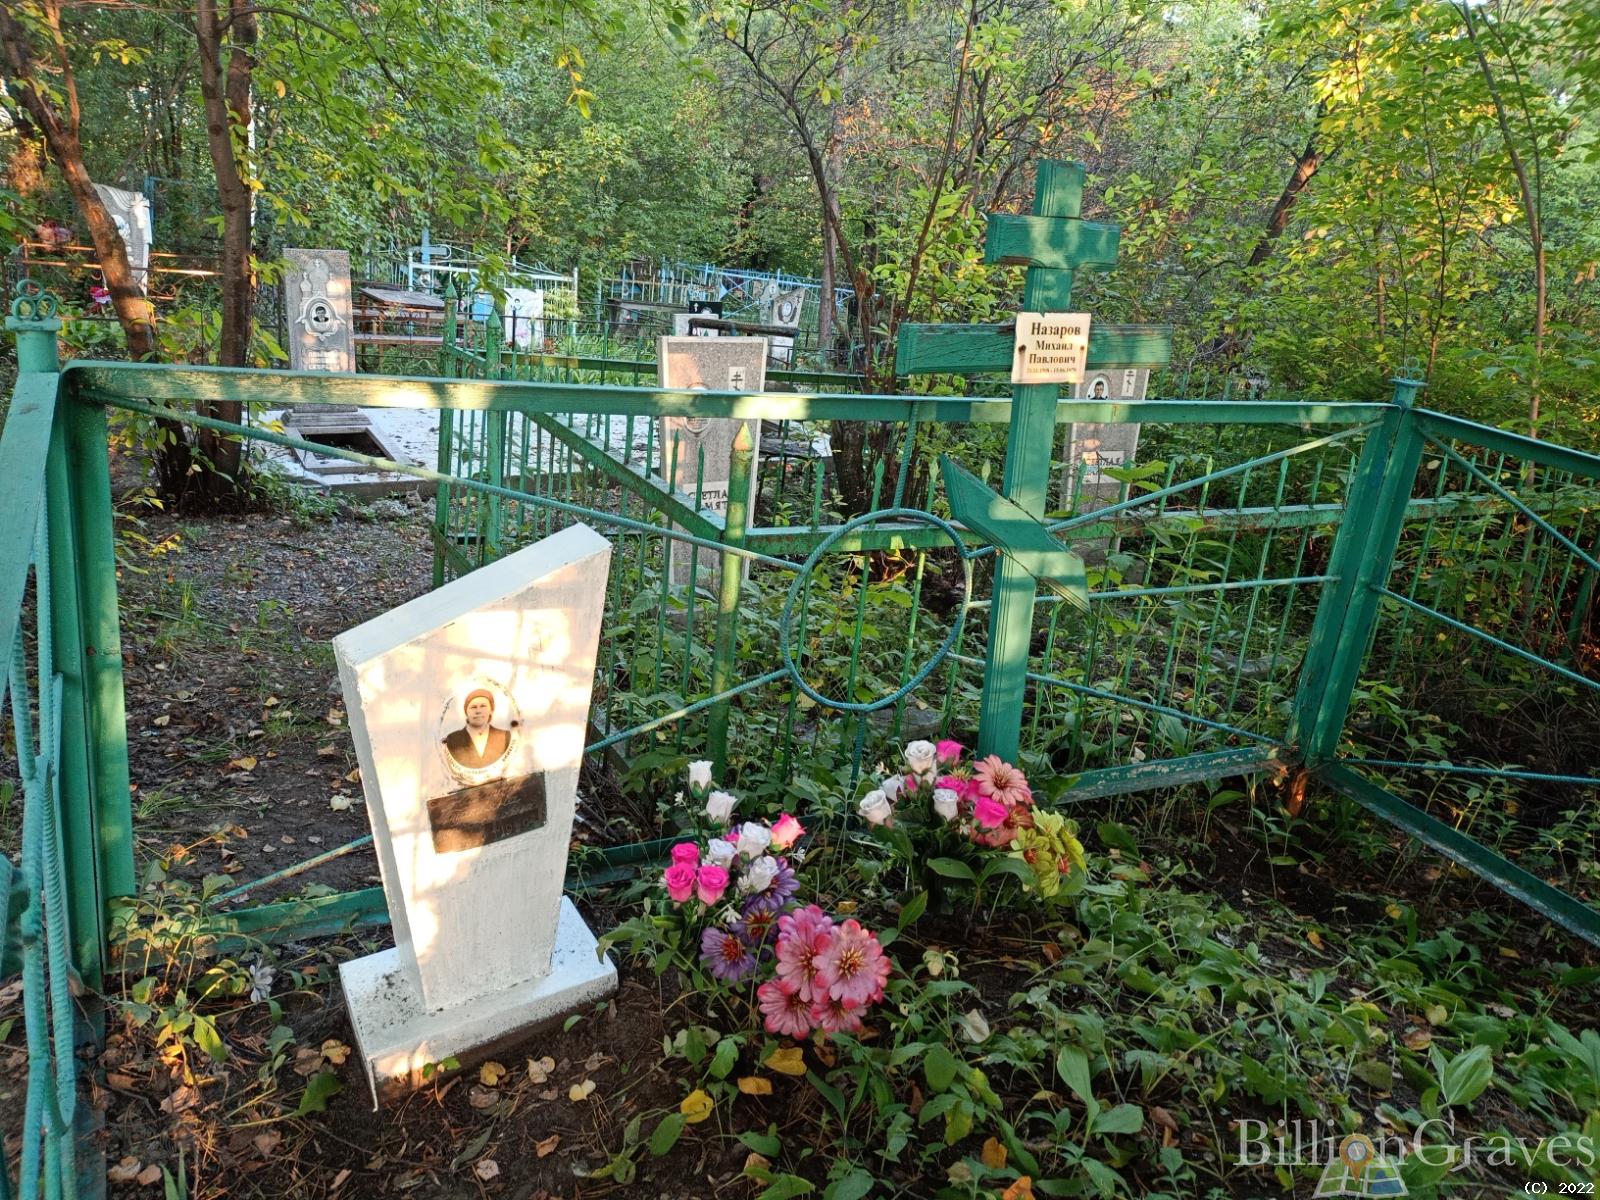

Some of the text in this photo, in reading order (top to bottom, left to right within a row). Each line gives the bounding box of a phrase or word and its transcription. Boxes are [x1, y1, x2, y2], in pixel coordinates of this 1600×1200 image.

[1031, 322, 1081, 339] Назаров
[1035, 340, 1073, 351] Михаил
[1029, 353, 1076, 364] Павлович
